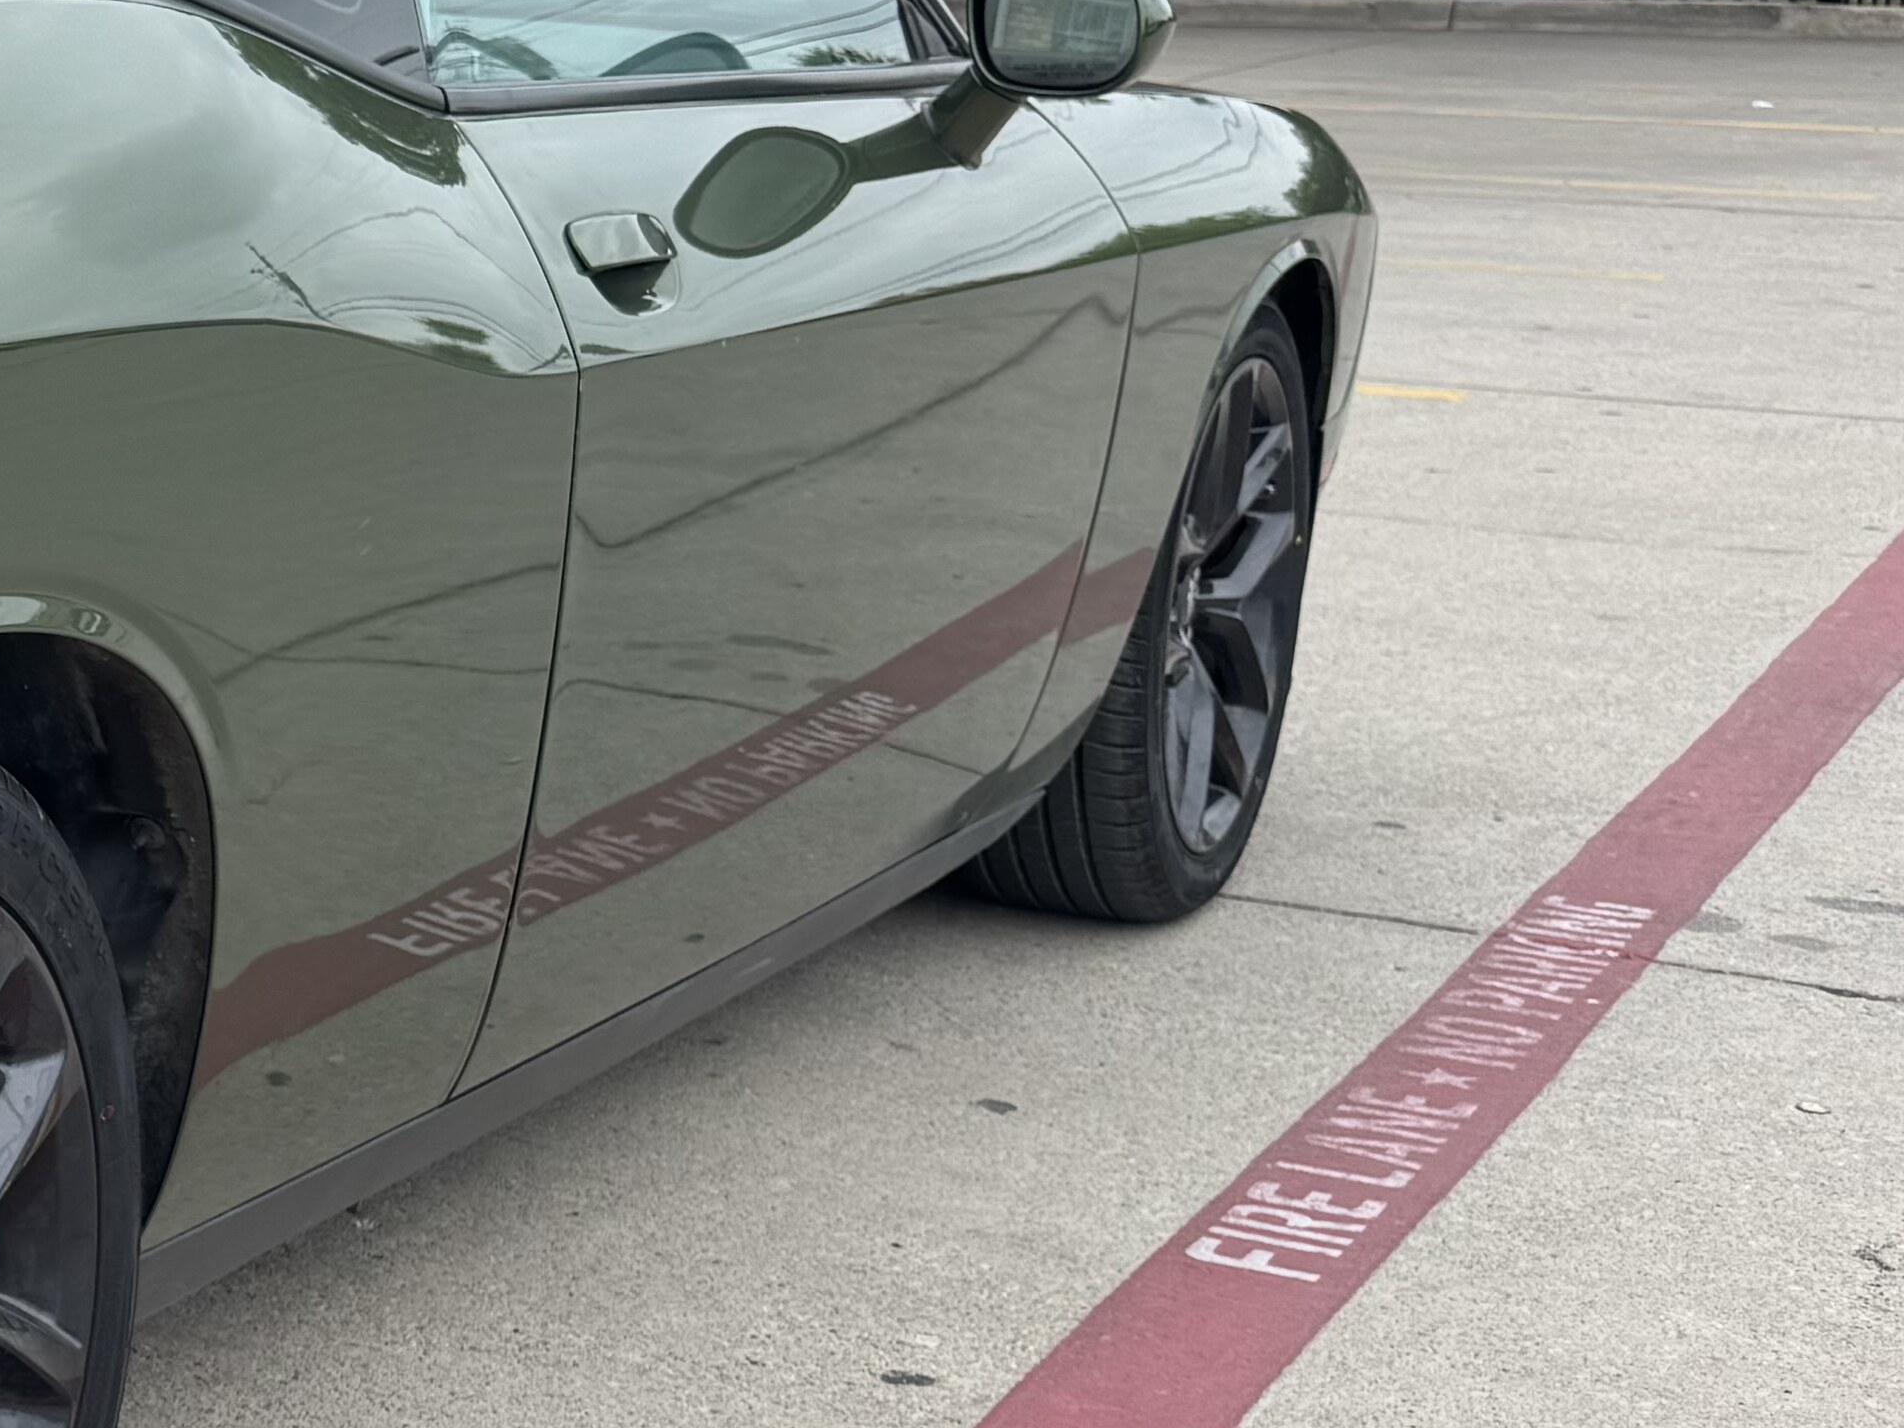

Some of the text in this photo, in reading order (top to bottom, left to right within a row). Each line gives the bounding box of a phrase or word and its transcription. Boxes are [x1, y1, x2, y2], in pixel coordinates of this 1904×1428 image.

[1185, 895, 1656, 1283] FIRE LANE NO PARKING
